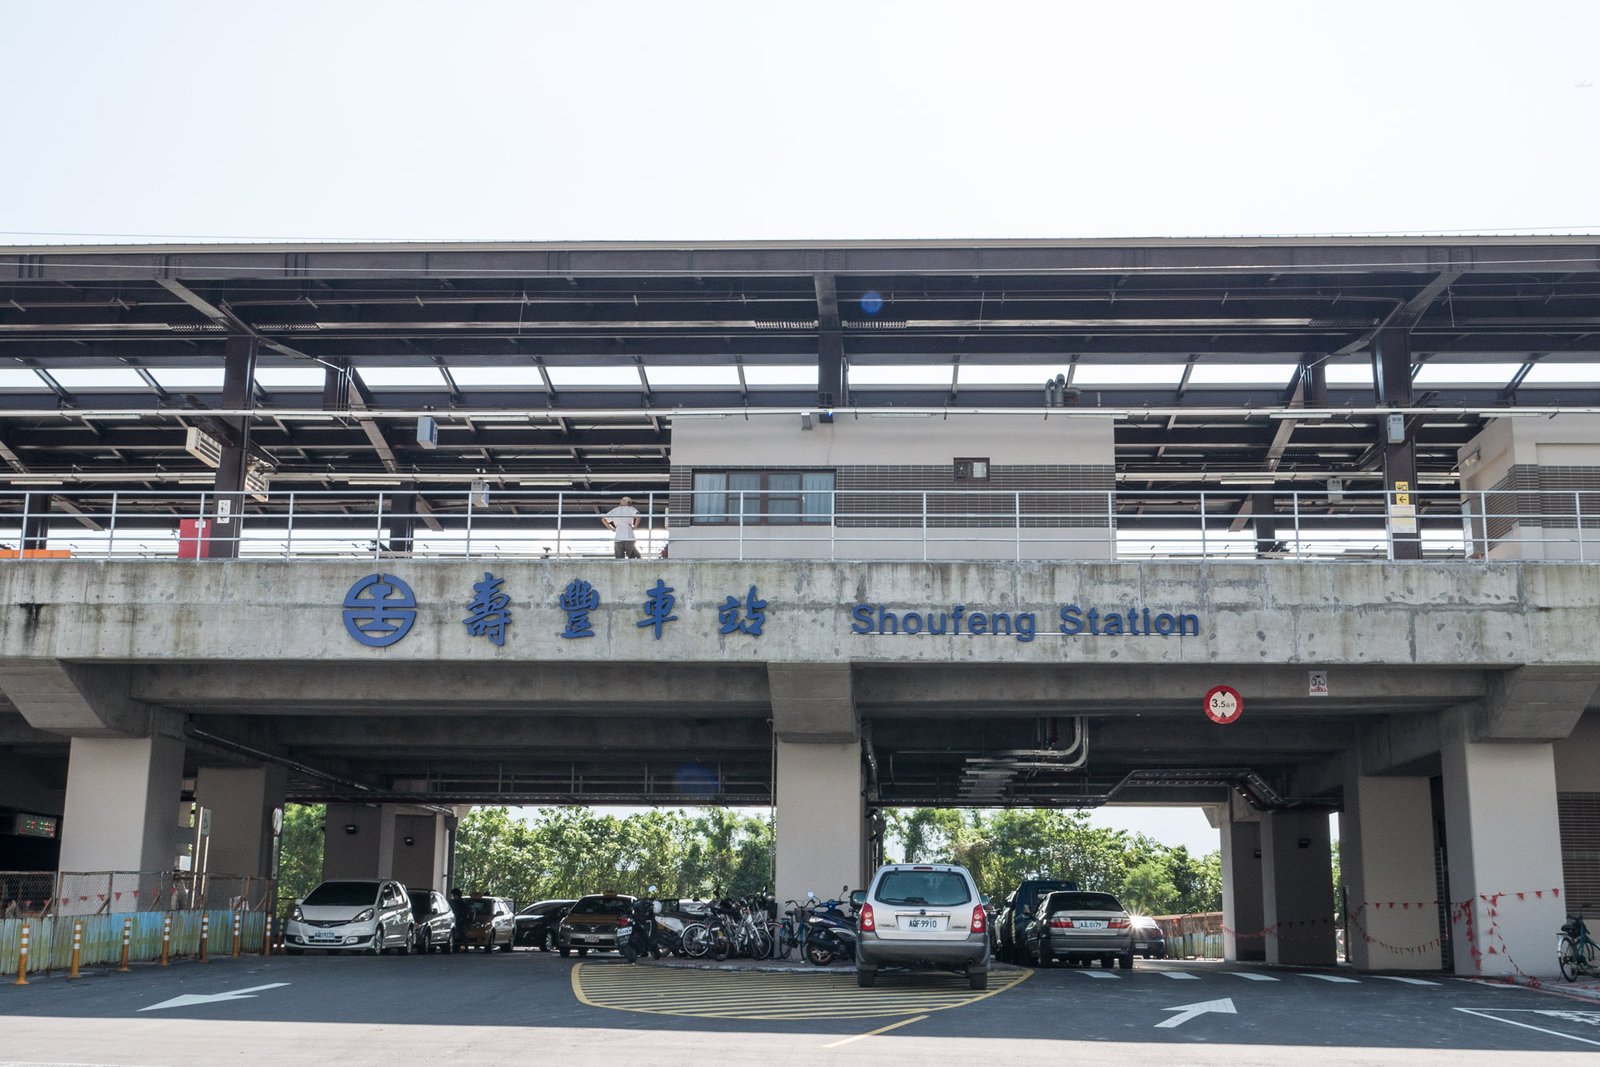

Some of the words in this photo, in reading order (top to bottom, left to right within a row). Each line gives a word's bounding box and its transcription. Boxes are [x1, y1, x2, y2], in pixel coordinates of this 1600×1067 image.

[462, 572, 767, 646] 壽豐車站
[851, 604, 1036, 642] Shoufeng
[1059, 605, 1199, 636] Station
